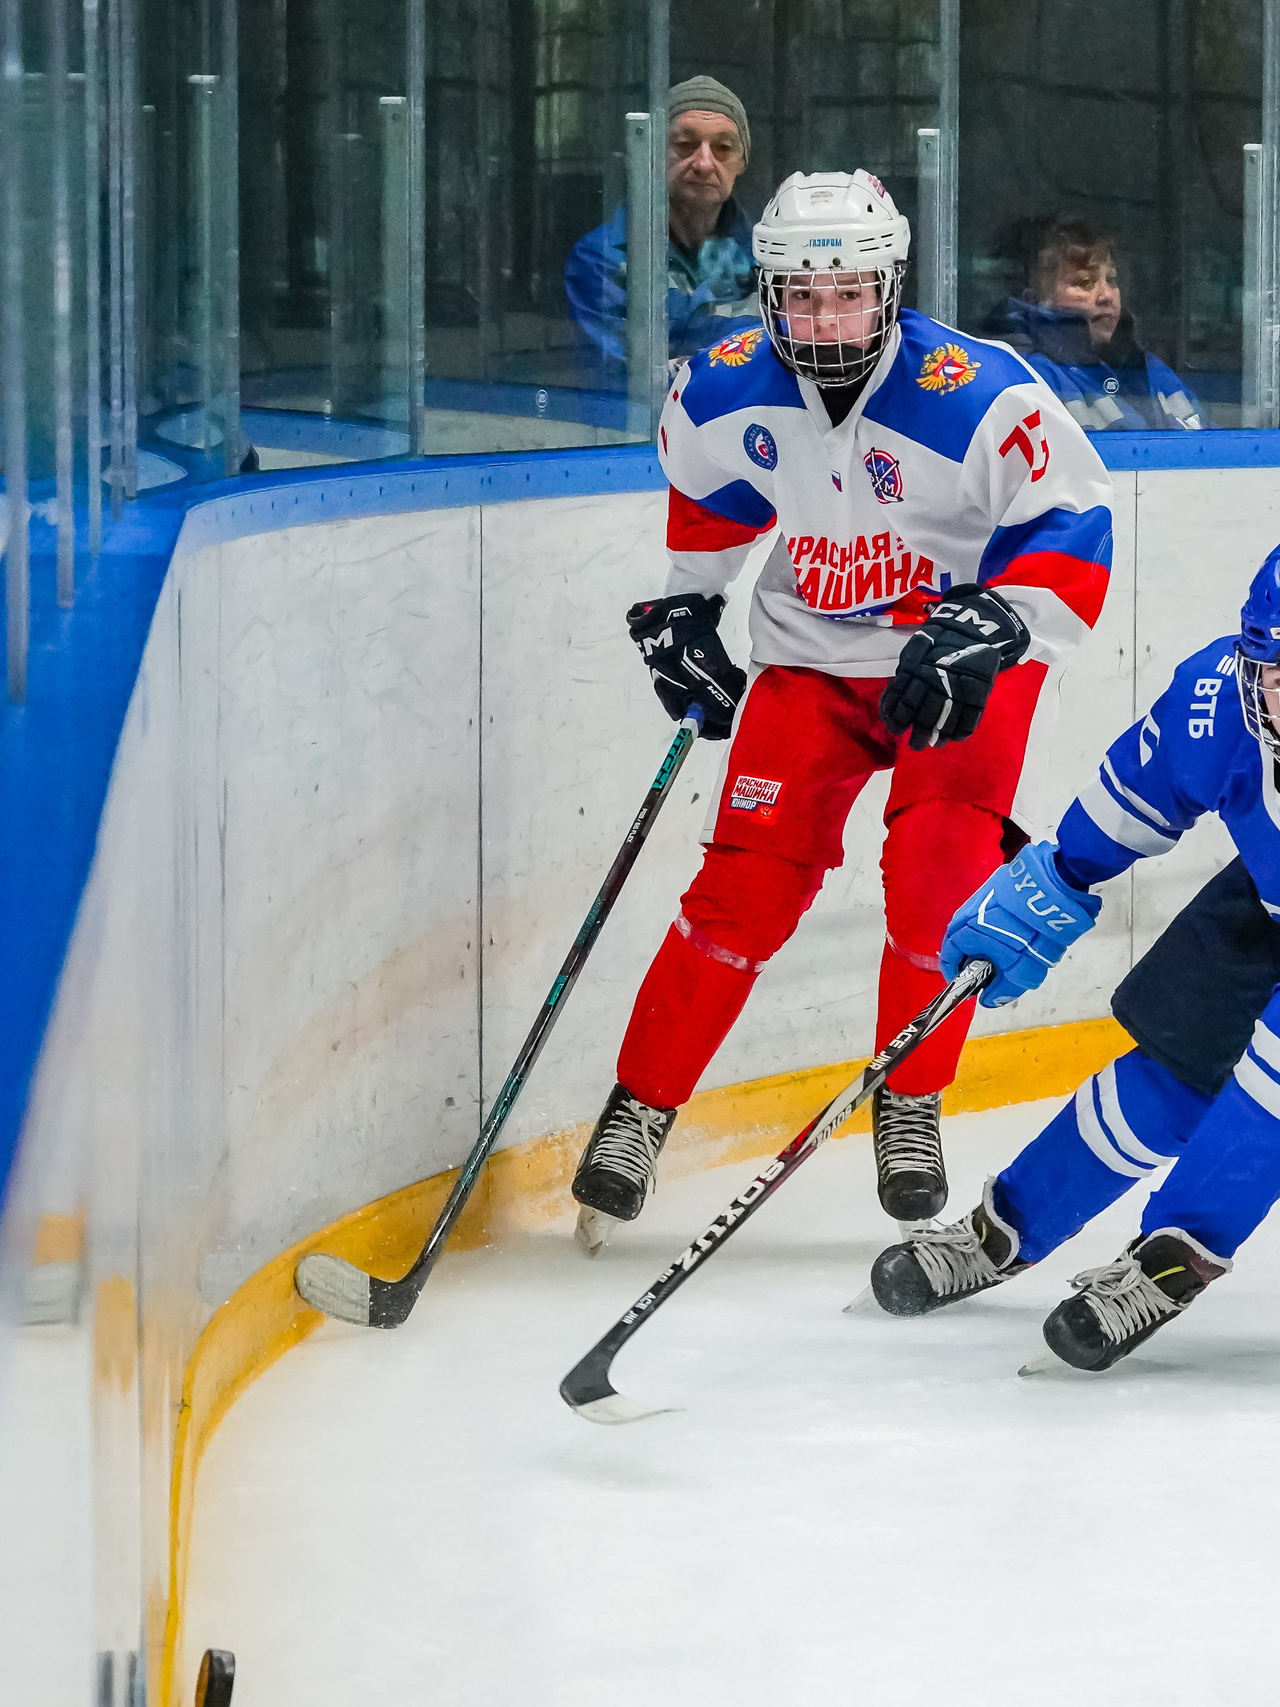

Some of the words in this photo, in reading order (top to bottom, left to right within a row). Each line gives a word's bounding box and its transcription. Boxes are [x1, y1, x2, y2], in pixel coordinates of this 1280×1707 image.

[927, 602, 1001, 636] CM
[706, 685, 731, 708] CCM
[1188, 677, 1223, 740] ВТБ
[731, 798, 757, 810] ЮНИОР
[1008, 857, 1077, 932] OYUZ
[889, 1023, 918, 1049] ACE
[868, 1050, 892, 1071] JNR
[674, 1160, 785, 1272] SOYUZ
